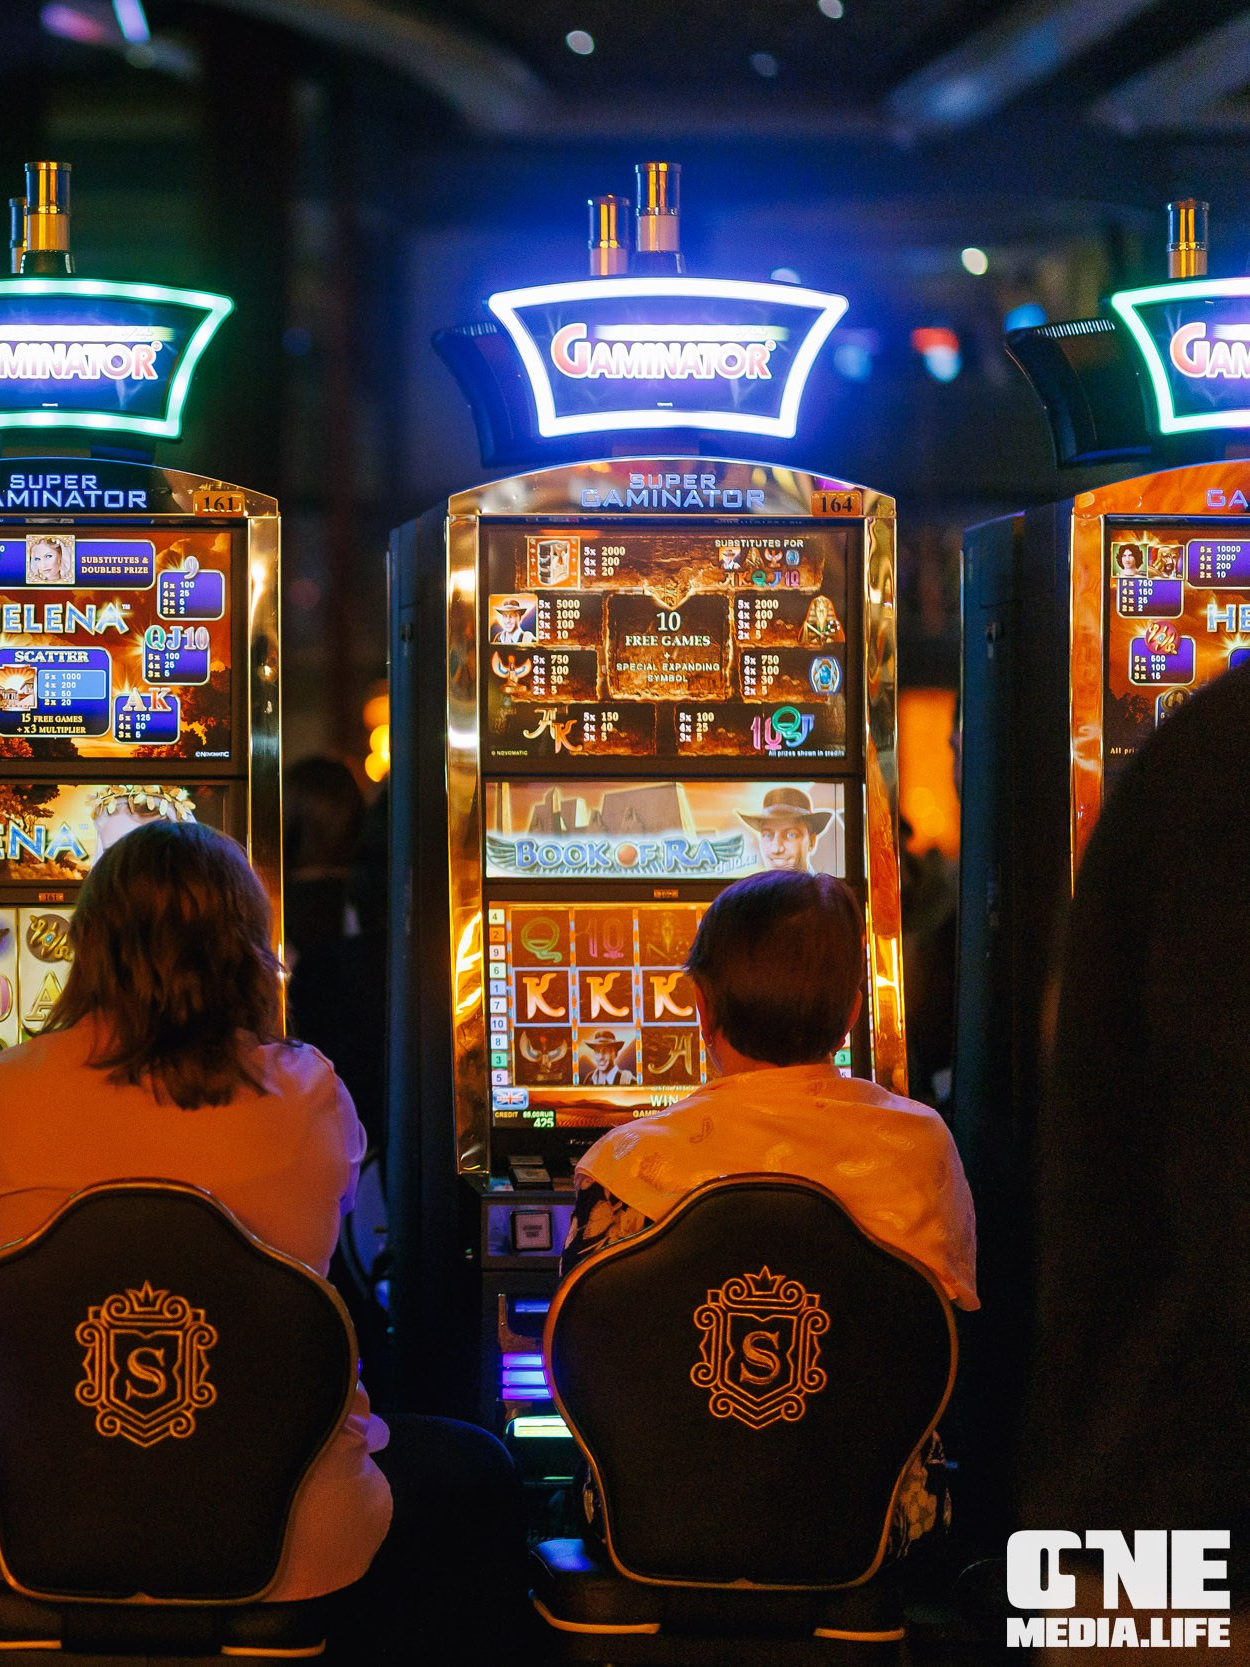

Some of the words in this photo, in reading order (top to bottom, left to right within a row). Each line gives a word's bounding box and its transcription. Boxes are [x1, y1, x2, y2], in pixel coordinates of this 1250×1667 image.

[9, 474, 98, 489] SUPER
[629, 474, 716, 489] SUPER
[581, 489, 765, 508] GAMINATOR
[202, 496, 234, 512] 161
[819, 495, 852, 513] 164
[602, 547, 625, 555] 2000
[584, 558, 596, 566] 4x
[602, 557, 619, 566] 200
[584, 568, 596, 576] 3x
[602, 567, 614, 576] 20
[539, 600, 550, 608] 5x
[557, 600, 580, 608] 5000
[738, 600, 750, 609] 5x
[755, 600, 779, 609] 2000
[539, 611, 550, 619] 4x
[557, 610, 580, 619] 1000
[738, 611, 750, 619] 4x
[755, 610, 772, 619] 400
[656, 612, 681, 632] 10
[625, 636, 658, 646] FREE
[662, 636, 710, 646] GAMES
[15, 651, 89, 662] SCATTER
[533, 656, 545, 664] 5x
[551, 655, 569, 664] 750
[616, 663, 657, 671] SPECIAL
[662, 663, 720, 671] EXPANDING
[22, 713, 31, 722] 15
[515, 838, 611, 868] BOOK
[616, 842, 661, 868] OF
[662, 837, 717, 868] RA
[739, 1331, 780, 1385] S
[126, 1347, 167, 1400] S
